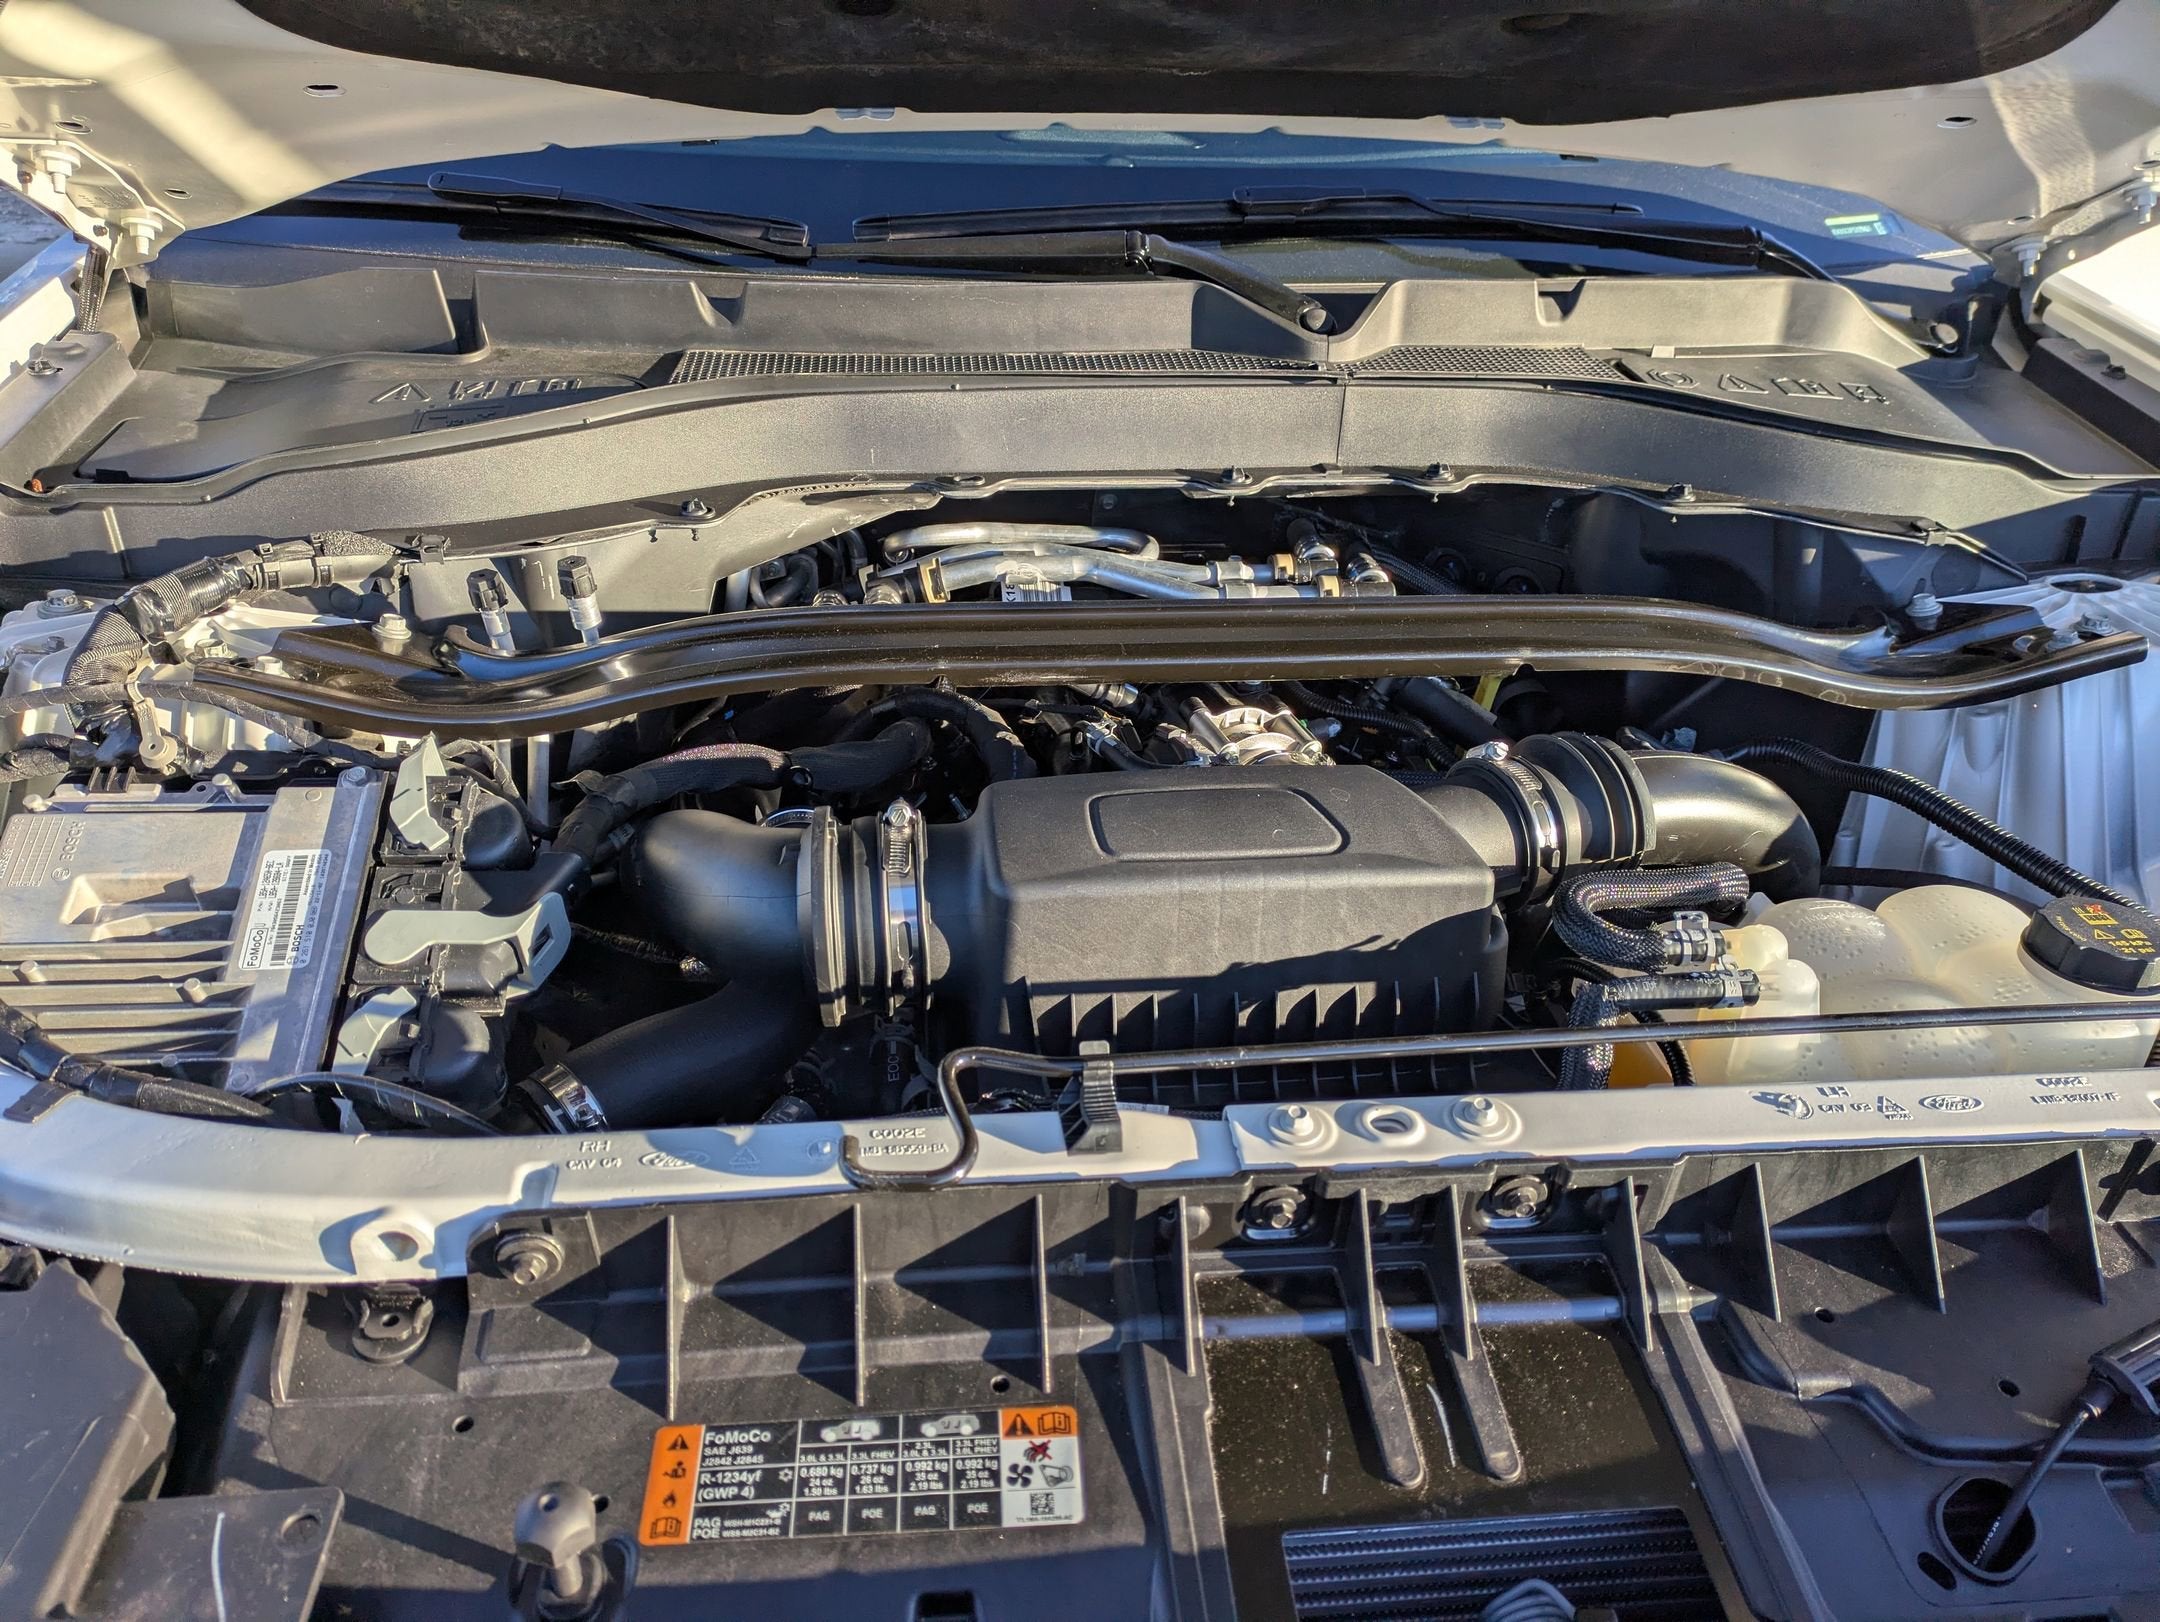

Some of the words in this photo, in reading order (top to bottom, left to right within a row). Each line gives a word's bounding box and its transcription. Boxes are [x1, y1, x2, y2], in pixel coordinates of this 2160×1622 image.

[291, 925, 304, 952] BOSCH
[247, 930, 264, 966] FoMoCo
[580, 1140, 612, 1153] RH
[704, 1430, 772, 1444] FoMoCo
[703, 1447, 726, 1456] SAE
[728, 1445, 753, 1455] J639
[819, 1454, 826, 1462] &
[904, 1460, 933, 1472] 0.992
[935, 1460, 948, 1473] kg
[955, 1459, 983, 1470] 0.992
[985, 1458, 998, 1470] kg
[800, 1467, 828, 1477] 0.680
[830, 1466, 844, 1478] kg
[851, 1464, 879, 1475] 0.737
[881, 1464, 894, 1476] kg
[965, 1470, 977, 1479] 35
[700, 1470, 763, 1485] R-1234yf
[809, 1478, 821, 1486] 24
[860, 1476, 872, 1484] 26
[873, 1476, 884, 1484] oz
[915, 1472, 926, 1481] 35
[855, 1485, 874, 1494] 1.63
[875, 1484, 889, 1493] lbs
[909, 1482, 929, 1491] 2.19
[930, 1481, 944, 1490] lbs
[960, 1480, 979, 1489] 2.19
[981, 1479, 995, 1488] lbs
[697, 1487, 738, 1502] (GWP
[740, 1486, 755, 1499] 4)
[803, 1488, 822, 1496] 1.50
[823, 1487, 838, 1496] lbs
[914, 1505, 936, 1516] PAG
[967, 1502, 989, 1513] POE
[808, 1510, 830, 1522] PAG
[861, 1508, 884, 1519] POE
[694, 1517, 721, 1528] PAG
[692, 1528, 720, 1539] POE
